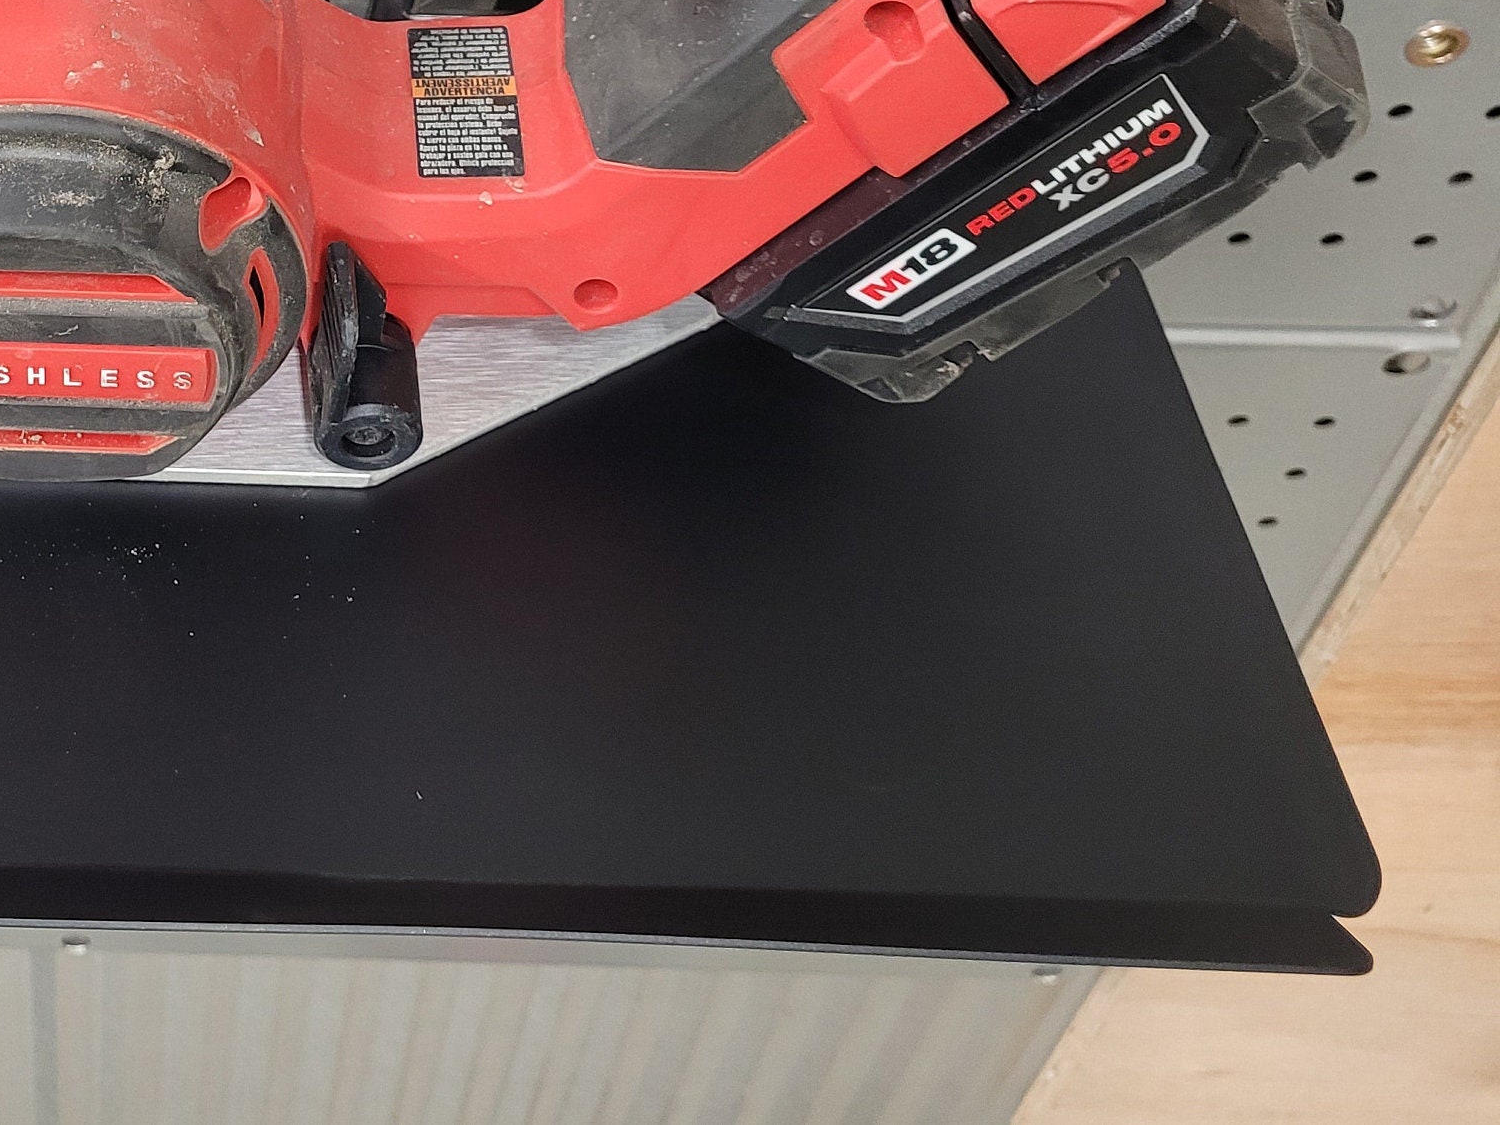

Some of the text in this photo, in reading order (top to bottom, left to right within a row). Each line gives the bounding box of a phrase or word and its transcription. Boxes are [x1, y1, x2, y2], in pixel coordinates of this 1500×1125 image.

[414, 78, 510, 88] AVERTISSEMENT
[424, 87, 505, 96] ADVERTENCIA
[1047, 121, 1183, 213] XC5.0
[859, 98, 1175, 303] M18 REDLITHIUM
